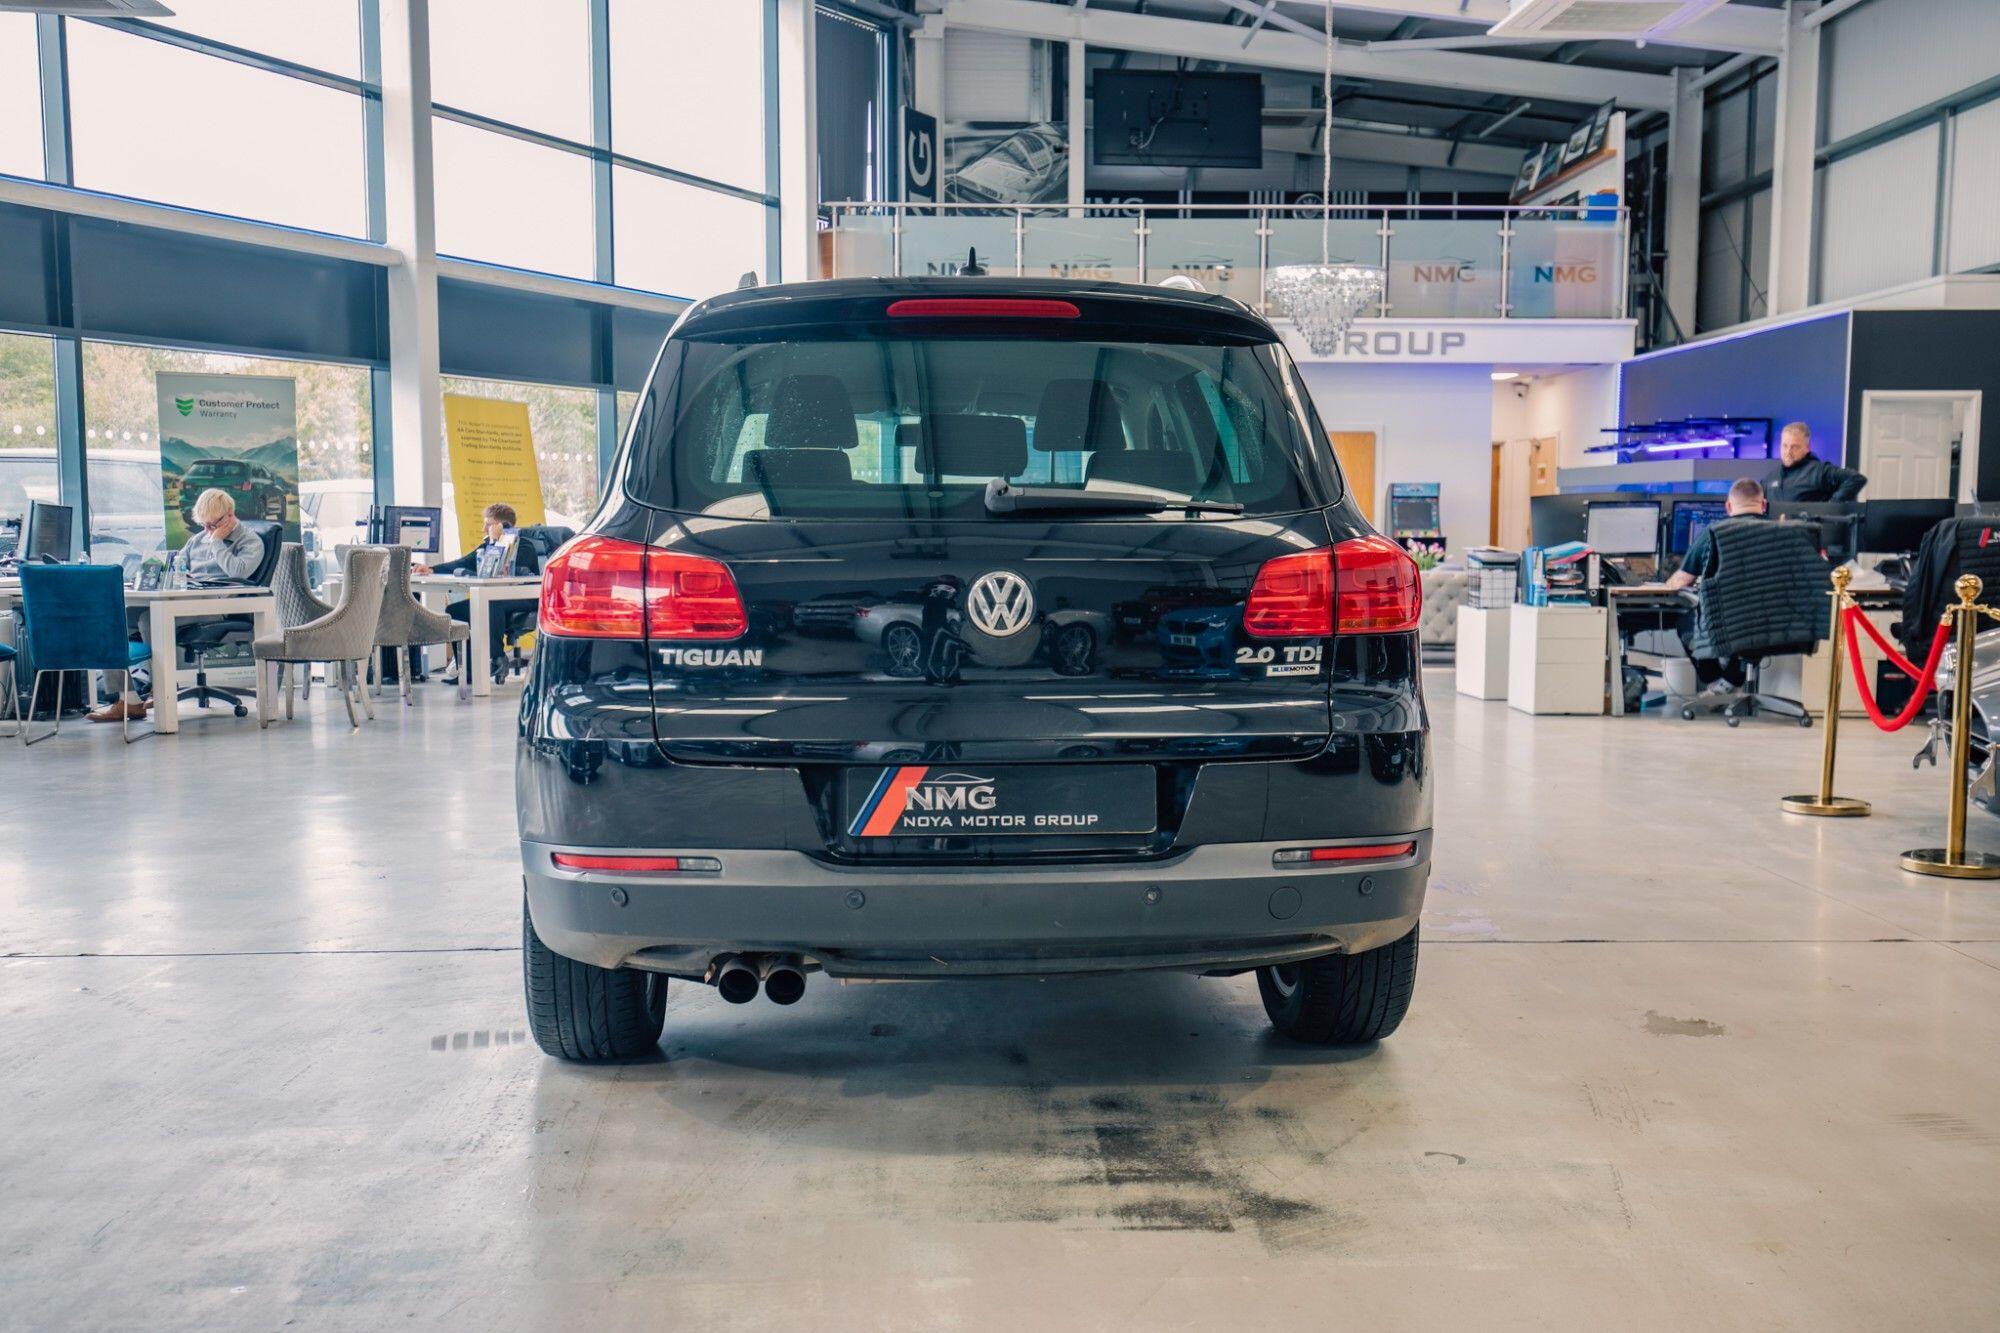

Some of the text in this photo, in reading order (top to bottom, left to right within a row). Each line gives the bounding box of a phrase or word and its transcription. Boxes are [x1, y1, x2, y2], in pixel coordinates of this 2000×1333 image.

[1533, 265, 1598, 283] NMG
[199, 399, 280, 410] Customer Protect
[199, 410, 238, 419] Warranty
[658, 648, 764, 667] TIGUAN
[1283, 645, 1324, 663] TDI
[905, 786, 998, 811] NMG
[903, 814, 1099, 828] NOYA MOTOR GROUP
